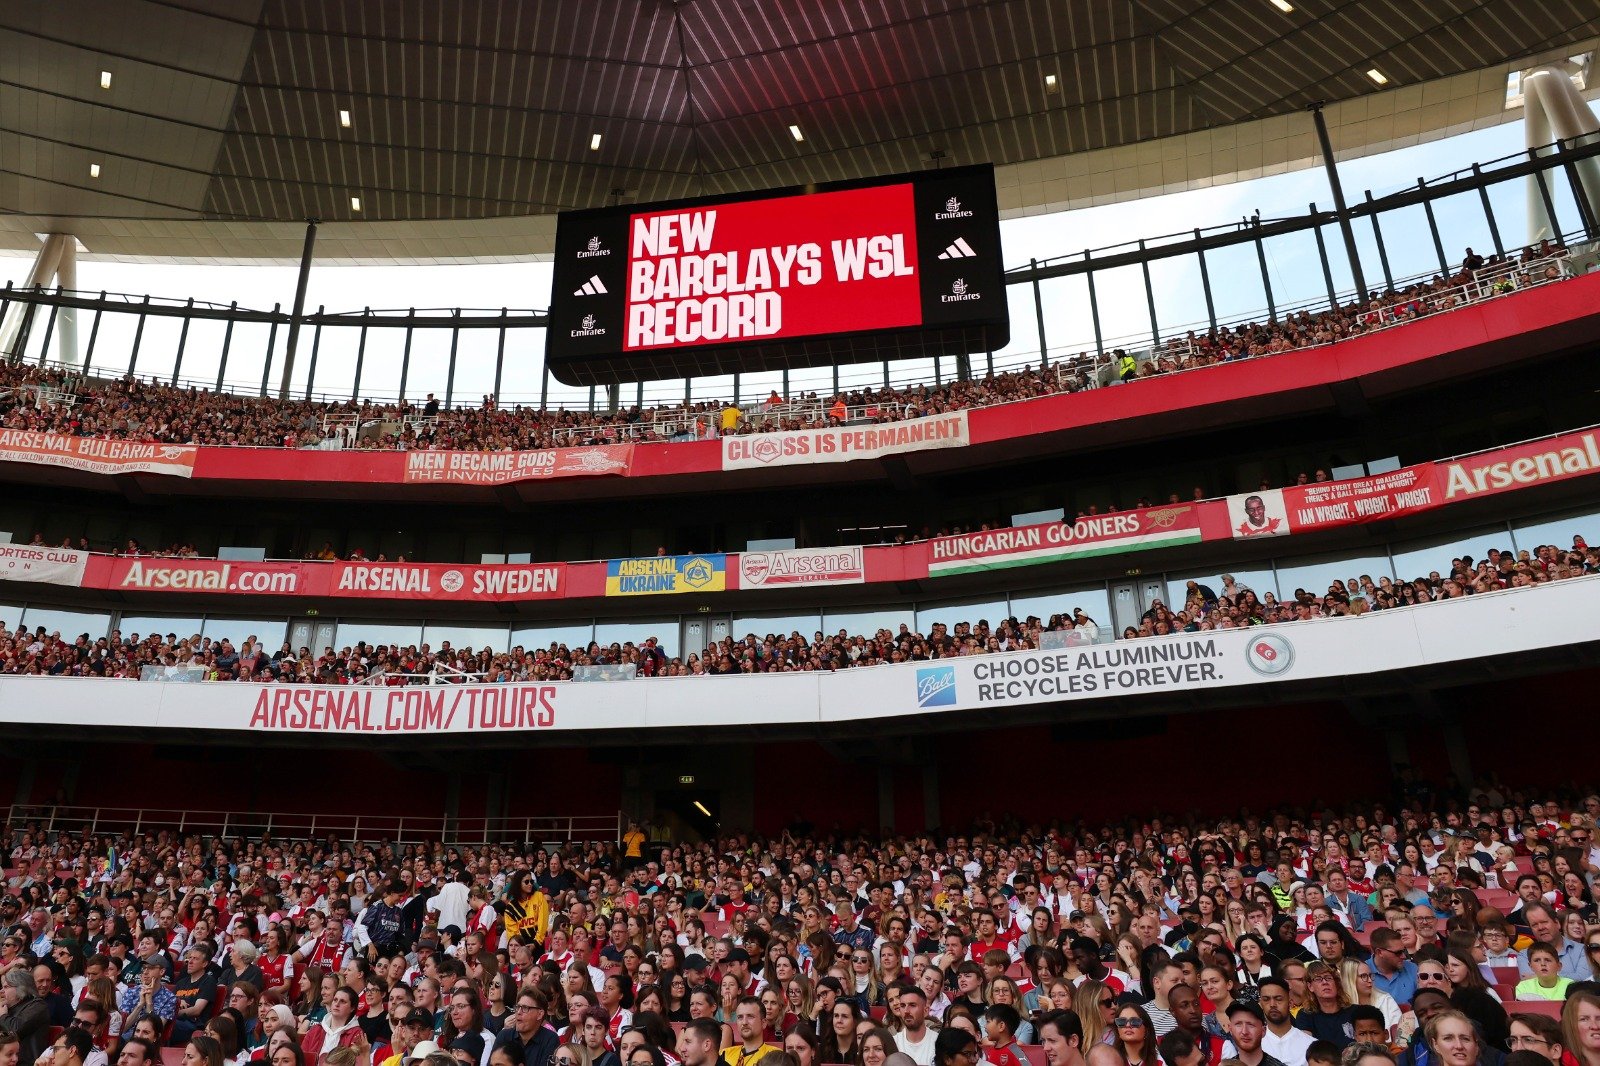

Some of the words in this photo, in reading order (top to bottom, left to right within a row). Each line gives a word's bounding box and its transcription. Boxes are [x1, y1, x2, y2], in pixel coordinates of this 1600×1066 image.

[935, 210, 973, 220] Emirates
[632, 210, 716, 258] NEW
[577, 249, 611, 259] Emirates
[630, 242, 822, 302] BARCLAYS
[831, 233, 914, 282] WSL
[941, 292, 981, 303] Emirates
[570, 327, 606, 338] Emirates
[627, 291, 782, 348] RECORD
[0, 431, 72, 452] ARSENAL
[78, 439, 155, 459] BULGARIA
[815, 433, 836, 454] IS
[841, 417, 962, 451] PERMANENT
[409, 452, 446, 470] MEN
[450, 453, 514, 472] BECAME
[517, 451, 557, 469] GODS
[409, 470, 443, 480] THE
[447, 466, 554, 482] INVINCIBLES
[1445, 433, 1600, 500] Arsenal
[1331, 483, 1351, 492] EVERY
[1375, 470, 1415, 485] GOALKEEPER
[1297, 508, 1316, 526] IAN
[1315, 502, 1355, 525] WRIGHT,
[1354, 495, 1396, 517] WRIGHT,
[1394, 487, 1432, 510] WRIGHT
[933, 528, 1041, 559] HUNGARIAN
[1046, 514, 1140, 542] GOONERS
[47, 552, 78, 564] CLUB
[619, 558, 678, 575] ARSENAL
[769, 548, 860, 575] Arsenal
[120, 561, 297, 592] Arsenal.com
[339, 567, 431, 592] ARSENAL
[472, 568, 558, 594] SWEDEN
[619, 574, 676, 592] UKRAINE
[296, 627, 307, 637] 45
[320, 628, 331, 638] 45
[974, 654, 1069, 680] CHOOSE
[1076, 639, 1224, 670] ALUMINIUM.
[918, 671, 953, 698] Ball
[978, 672, 1097, 702] RECYCLES
[1104, 662, 1224, 690] FOREVER.
[249, 686, 556, 731] ARSENAL.COM/TOURS
